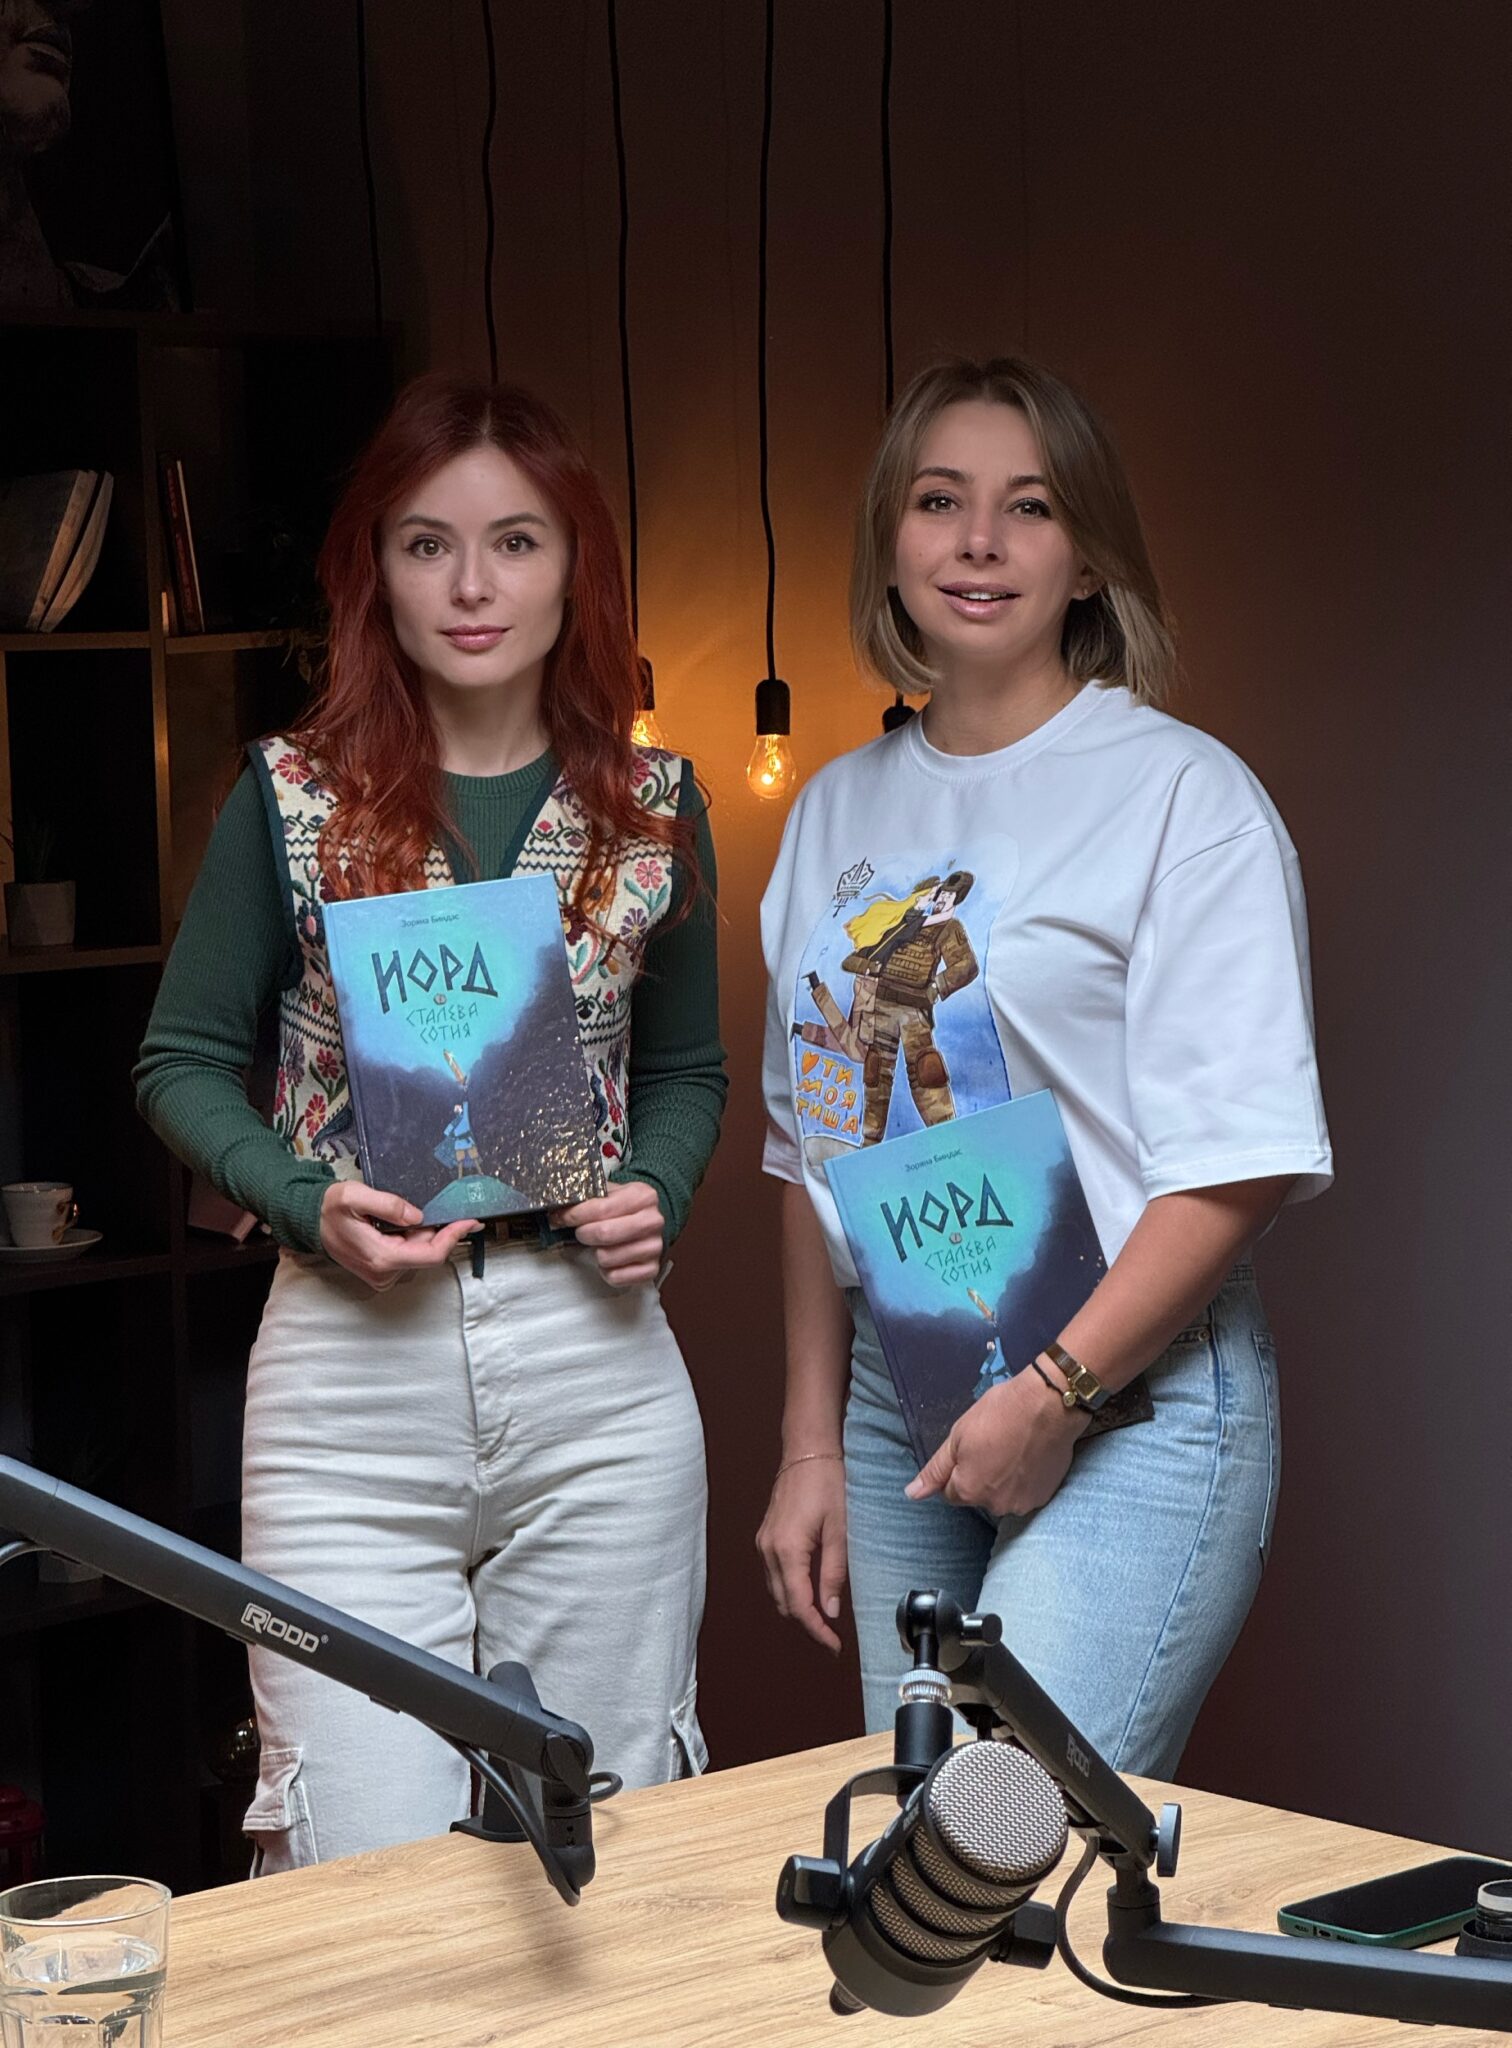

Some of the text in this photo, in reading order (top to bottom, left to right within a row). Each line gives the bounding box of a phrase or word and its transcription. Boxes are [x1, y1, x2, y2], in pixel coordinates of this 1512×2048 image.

[406, 1002, 479, 1027] СТАЛЕВА
[420, 1022, 471, 1044] СОТНЯ
[821, 1056, 853, 1087] ТИ
[796, 1078, 857, 1110] МОЯ
[796, 1096, 859, 1135] ТИША
[924, 1235, 997, 1271] СТАЛЕВА
[941, 1257, 992, 1286] СОТНЯ
